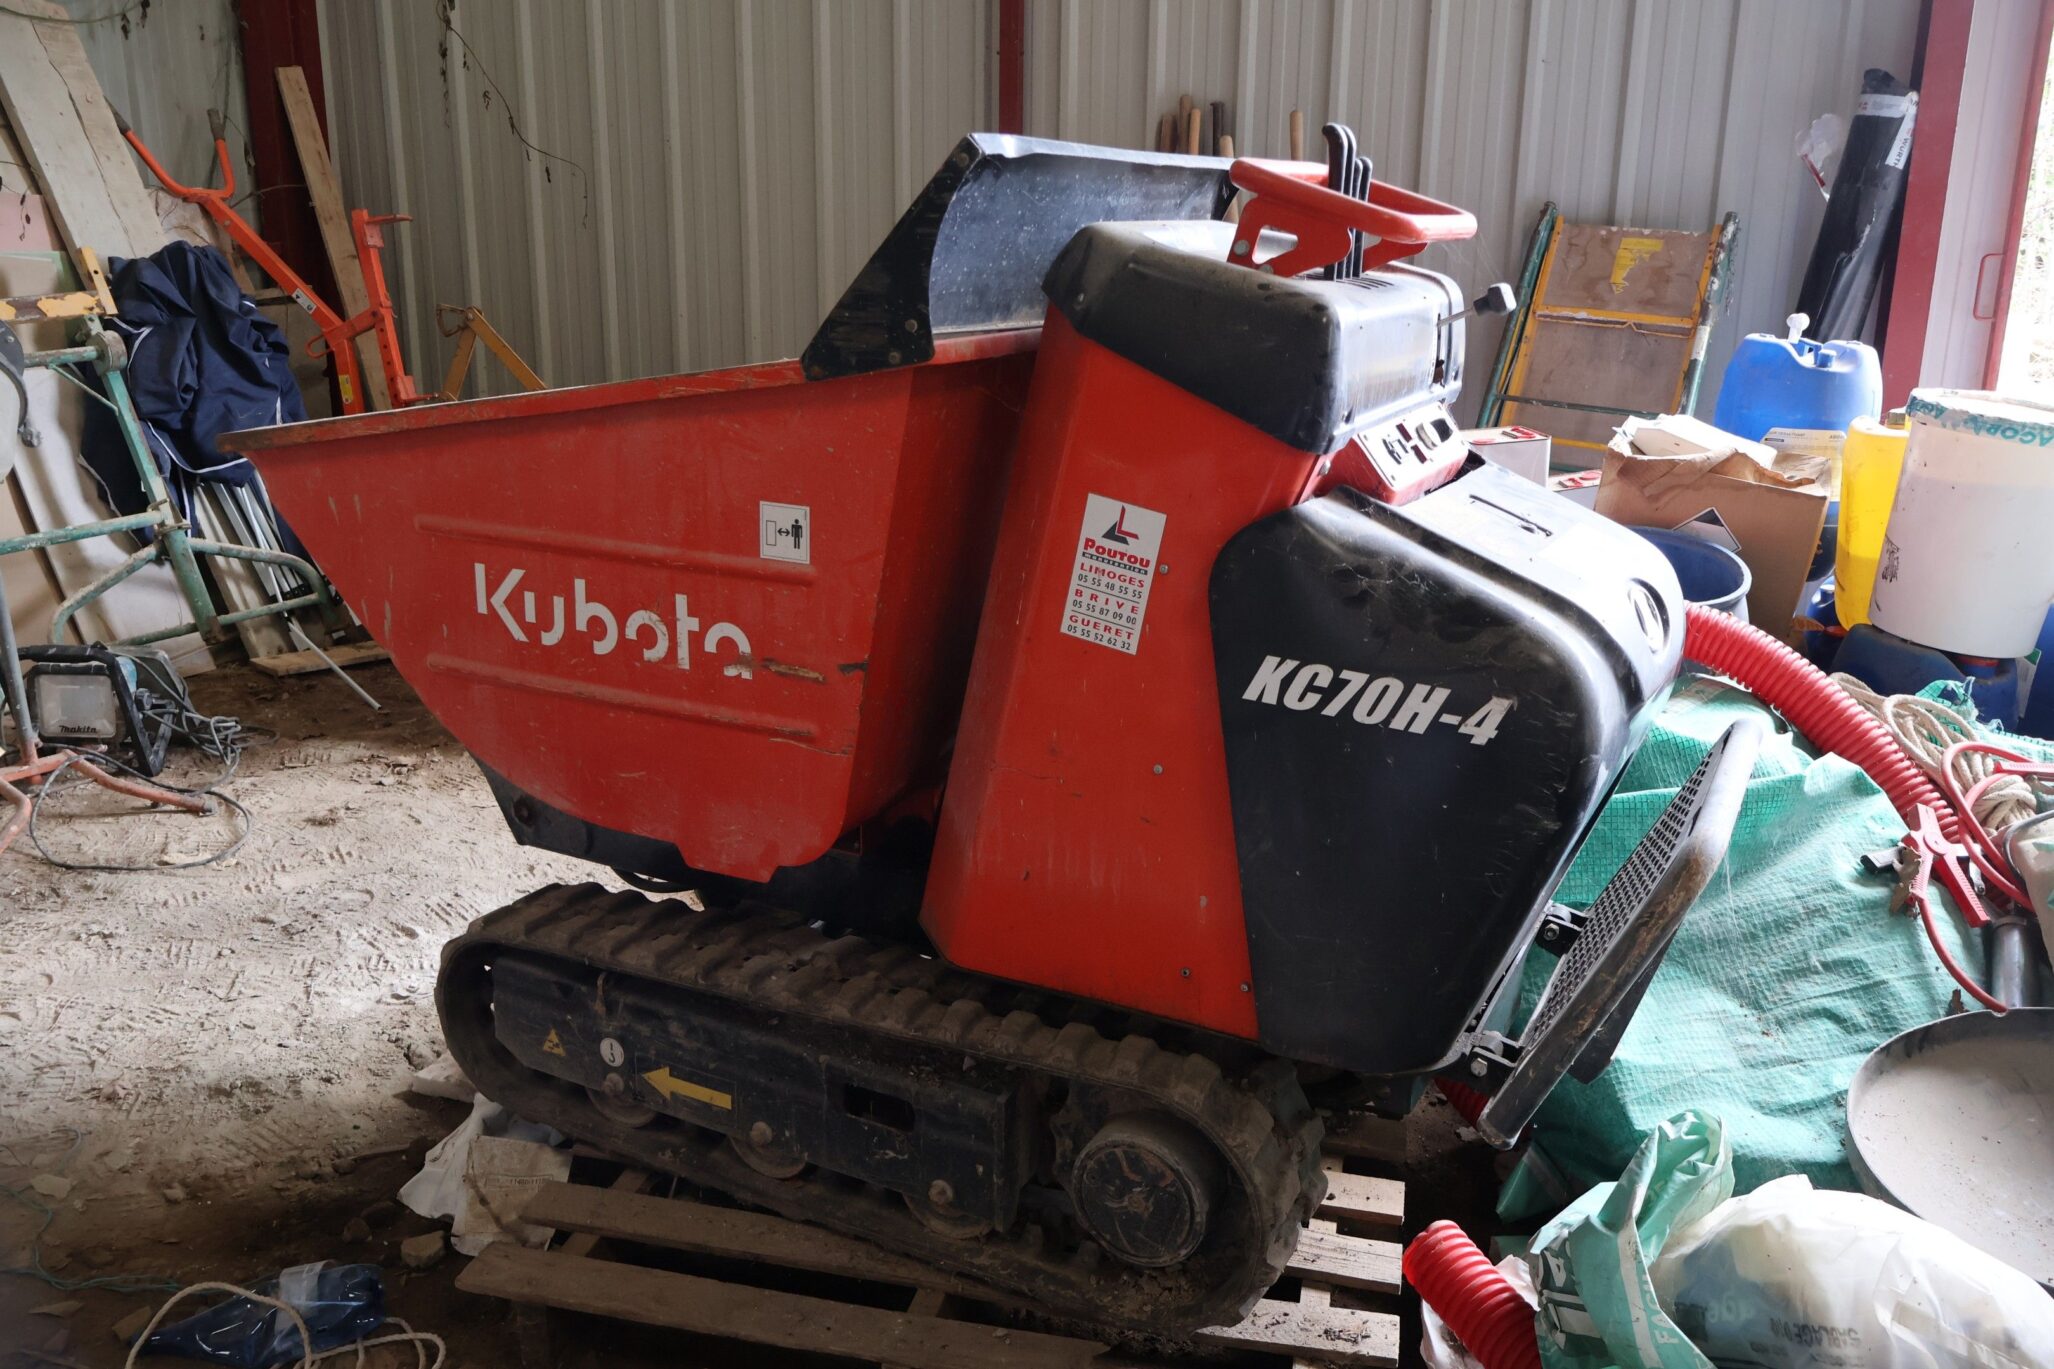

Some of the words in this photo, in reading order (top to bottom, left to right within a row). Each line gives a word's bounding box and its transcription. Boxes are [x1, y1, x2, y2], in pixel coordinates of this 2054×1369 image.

[1083, 537, 1150, 568] POUTOU
[1078, 573, 1088, 583] 05
[1091, 577, 1101, 587] 55
[1105, 582, 1115, 591] 48
[1118, 585, 1128, 595] 55
[1132, 589, 1142, 599] 55
[1080, 562, 1144, 588] LIMOGES
[1072, 599, 1083, 609] 05
[1086, 603, 1096, 613] 55
[1099, 607, 1109, 616] 87
[1112, 611, 1123, 621] 09
[1126, 615, 1137, 625] 00
[1074, 588, 1139, 614] BRIVE
[474, 563, 752, 680] Kubota
[1069, 614, 1133, 640] GUERET
[1067, 624, 1077, 634] 05
[1081, 628, 1091, 638] 55
[1094, 633, 1104, 642] 52
[1107, 637, 1117, 646] 62
[1120, 641, 1131, 651] 32
[1242, 655, 1517, 746] KC70H-4
